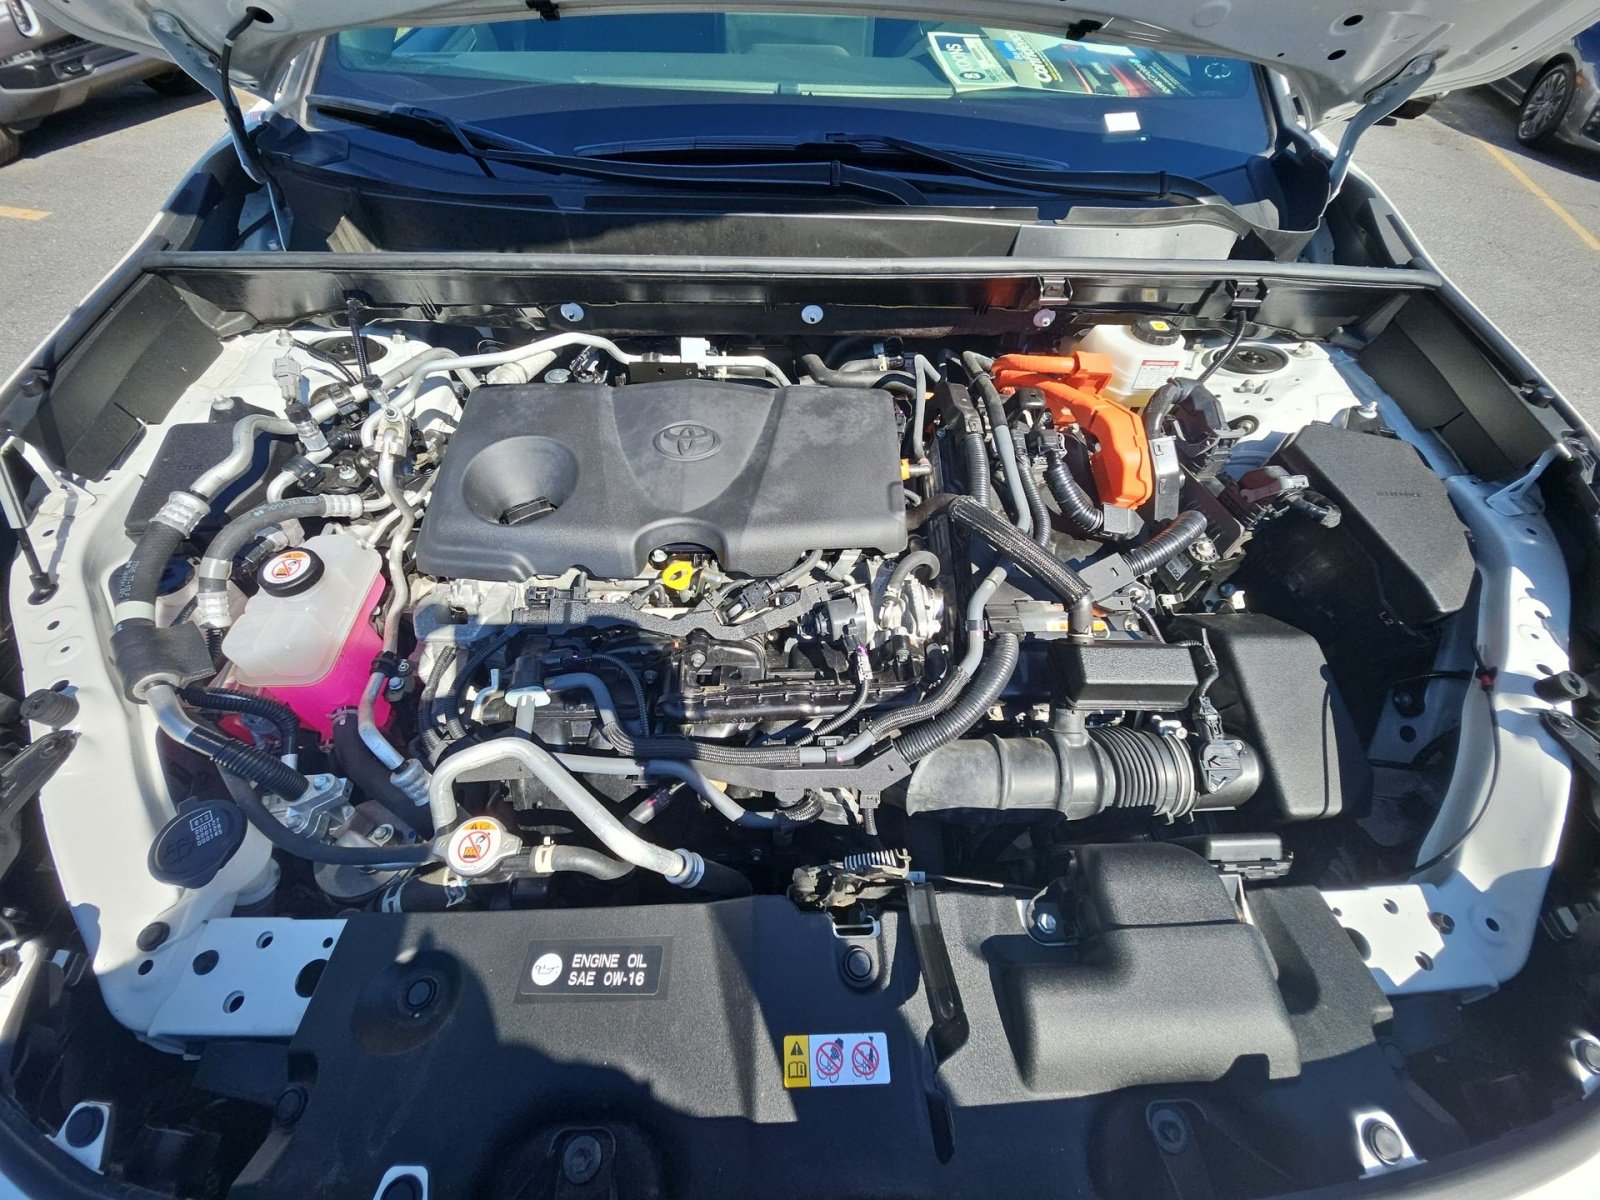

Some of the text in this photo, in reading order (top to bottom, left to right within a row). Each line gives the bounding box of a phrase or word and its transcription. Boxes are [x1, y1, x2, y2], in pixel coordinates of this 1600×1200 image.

[945, 43, 974, 72] KOONS
[571, 953, 648, 968] ENGINE OIL
[567, 970, 646, 986] SAE 0W-16
